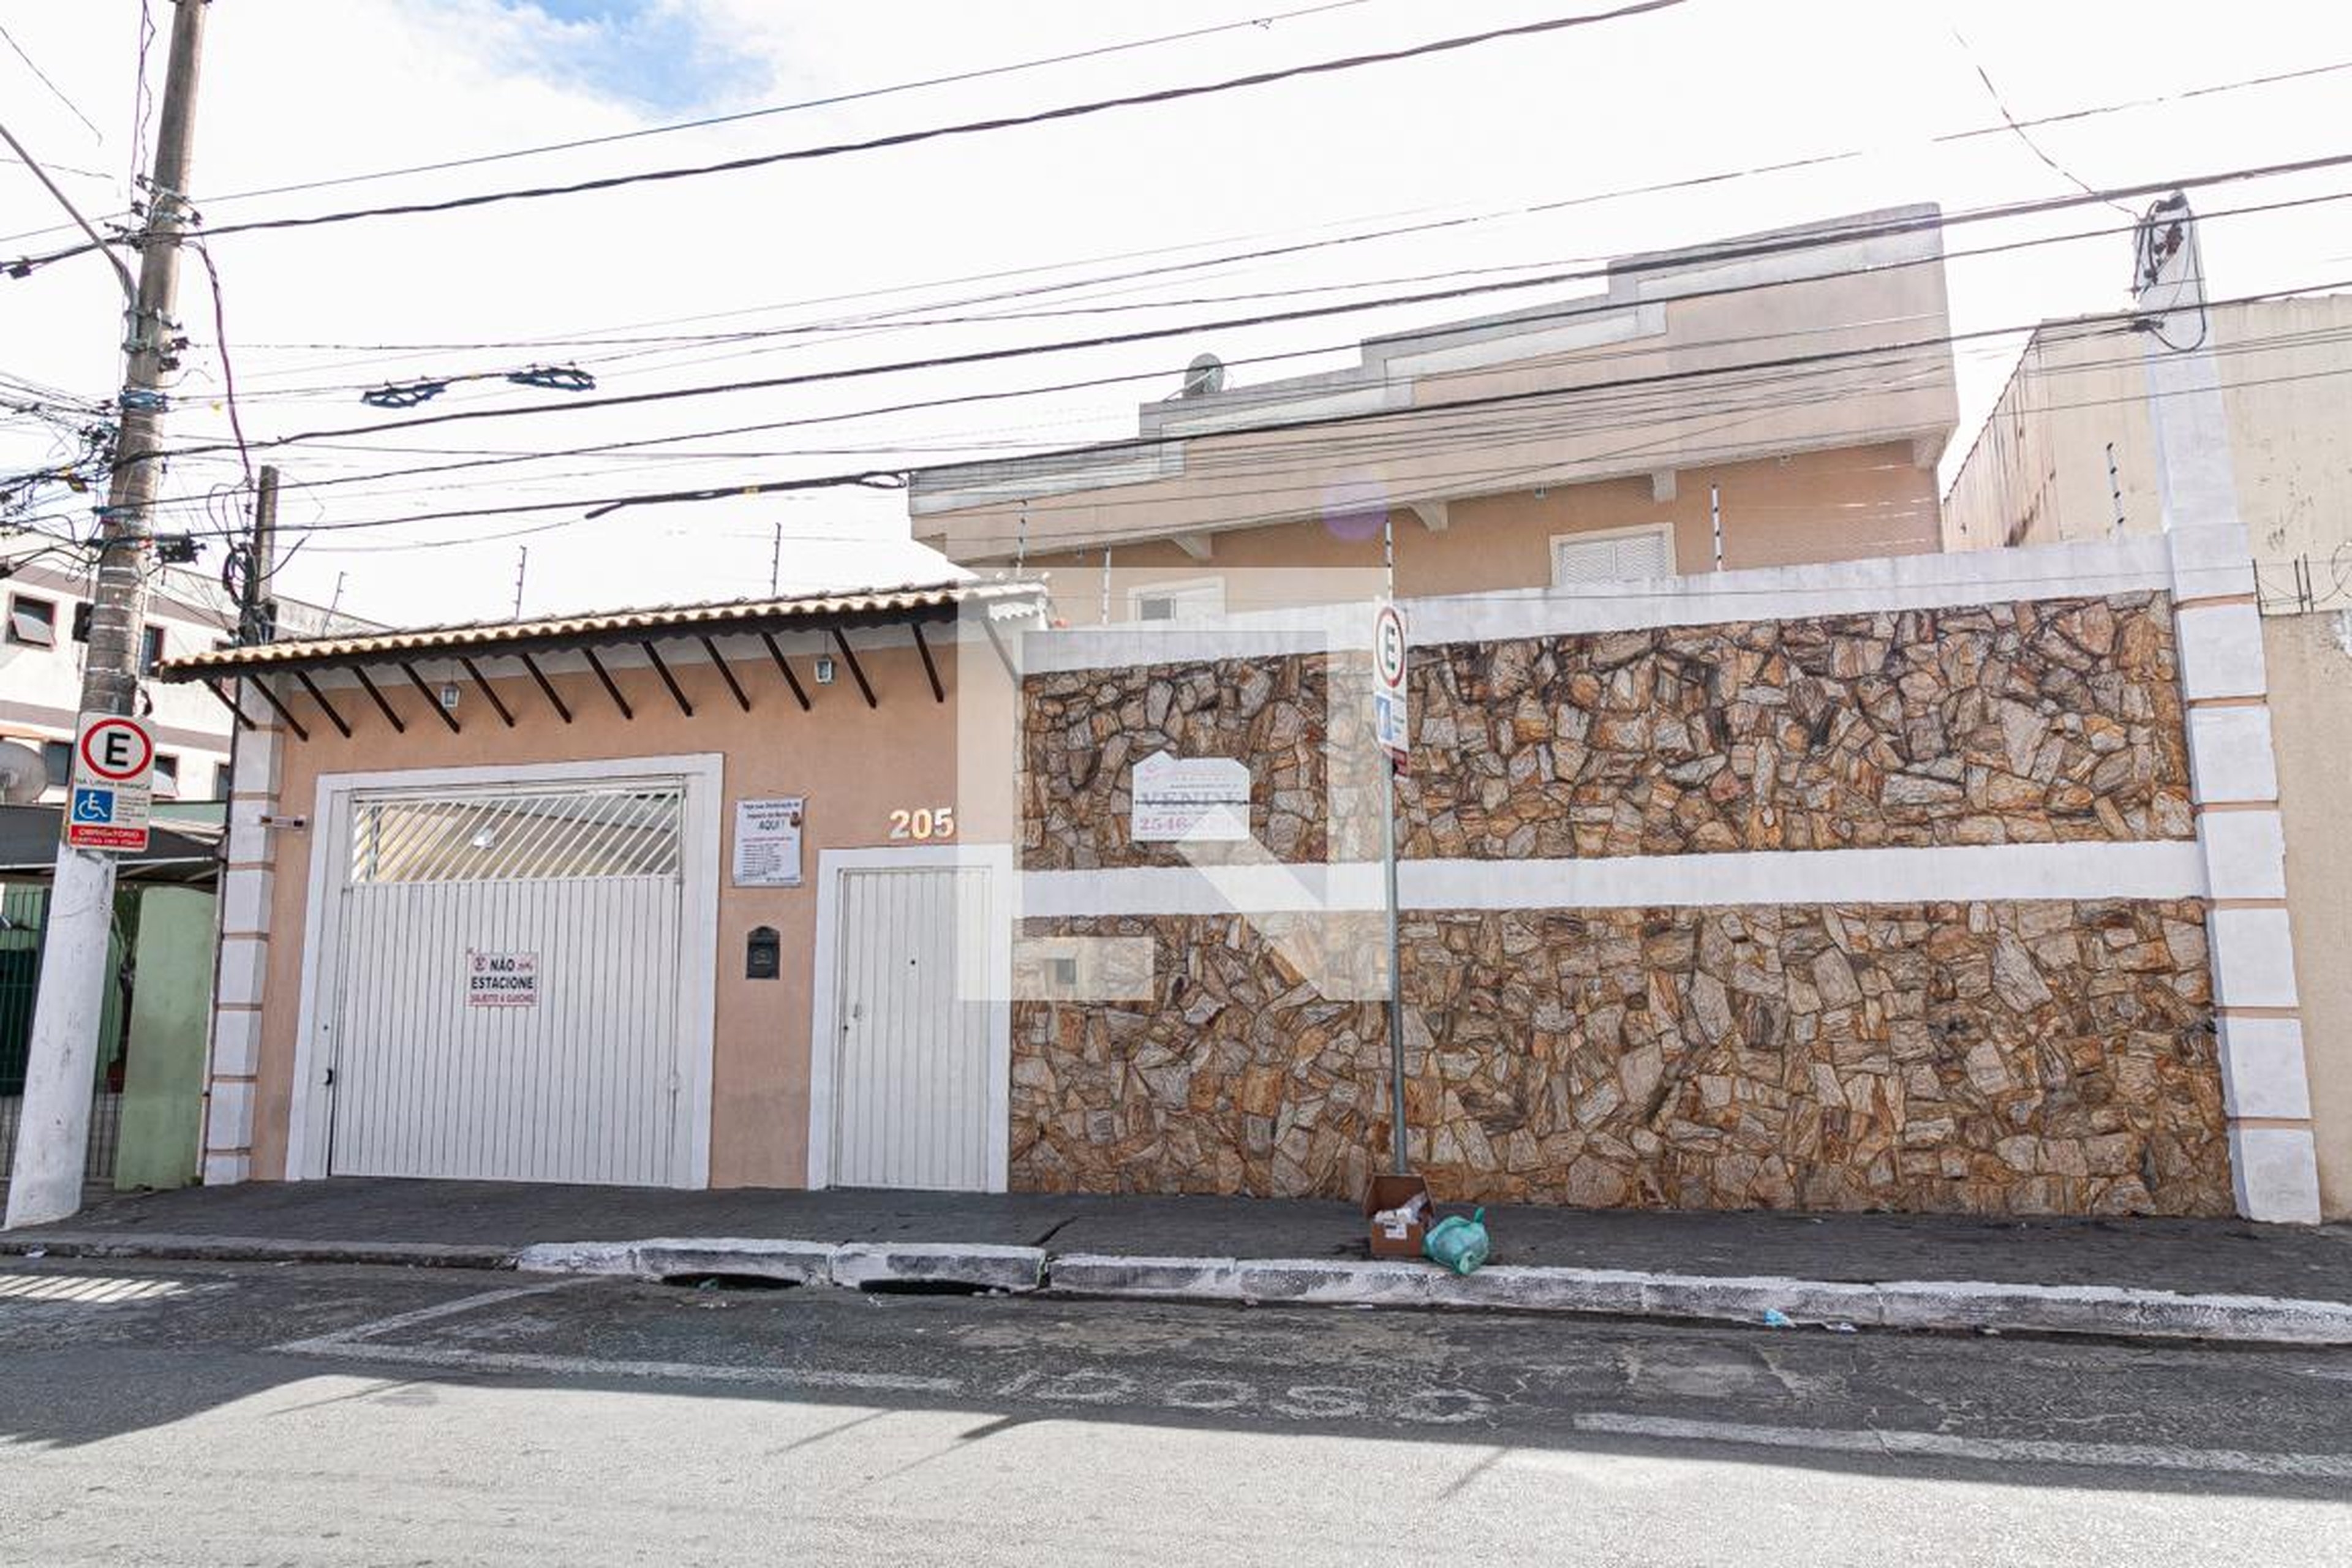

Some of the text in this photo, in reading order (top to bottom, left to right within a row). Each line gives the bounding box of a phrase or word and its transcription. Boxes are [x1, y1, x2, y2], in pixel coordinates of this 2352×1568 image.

[105, 732, 130, 766] E
[890, 808, 954, 840] 205
[491, 956, 515, 971] NÃO
[471, 976, 533, 989] ESTACIONE
